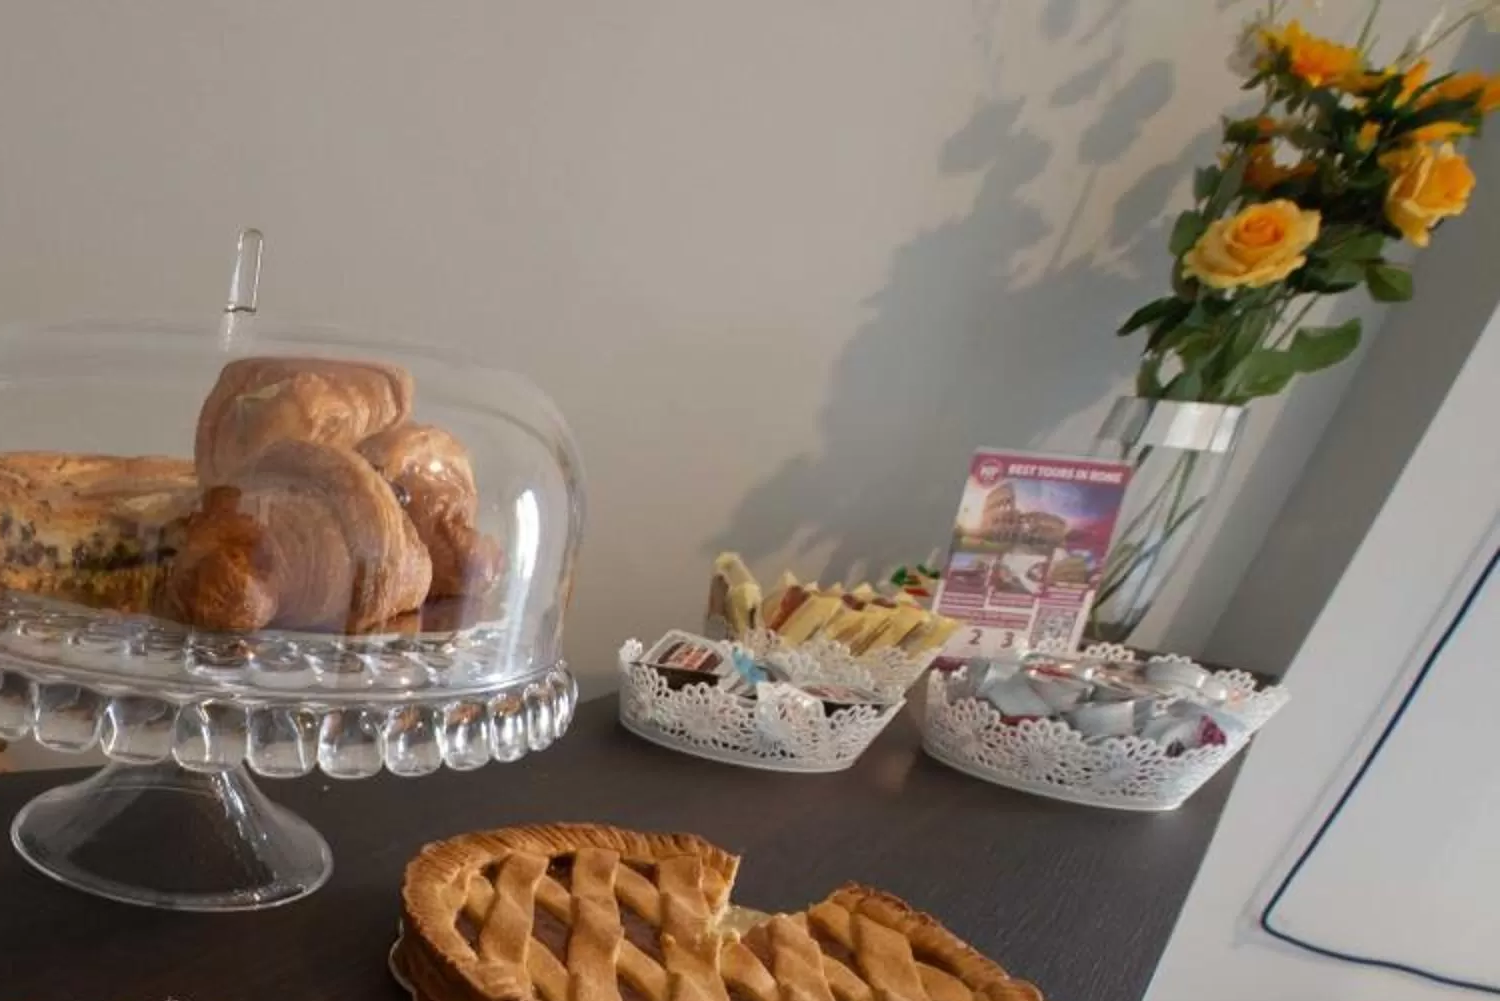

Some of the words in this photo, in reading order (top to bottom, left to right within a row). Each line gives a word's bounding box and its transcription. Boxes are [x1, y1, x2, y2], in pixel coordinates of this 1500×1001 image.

[1008, 464, 1037, 477] BEST
[968, 628, 983, 645] 2
[1000, 631, 1014, 649] 3
